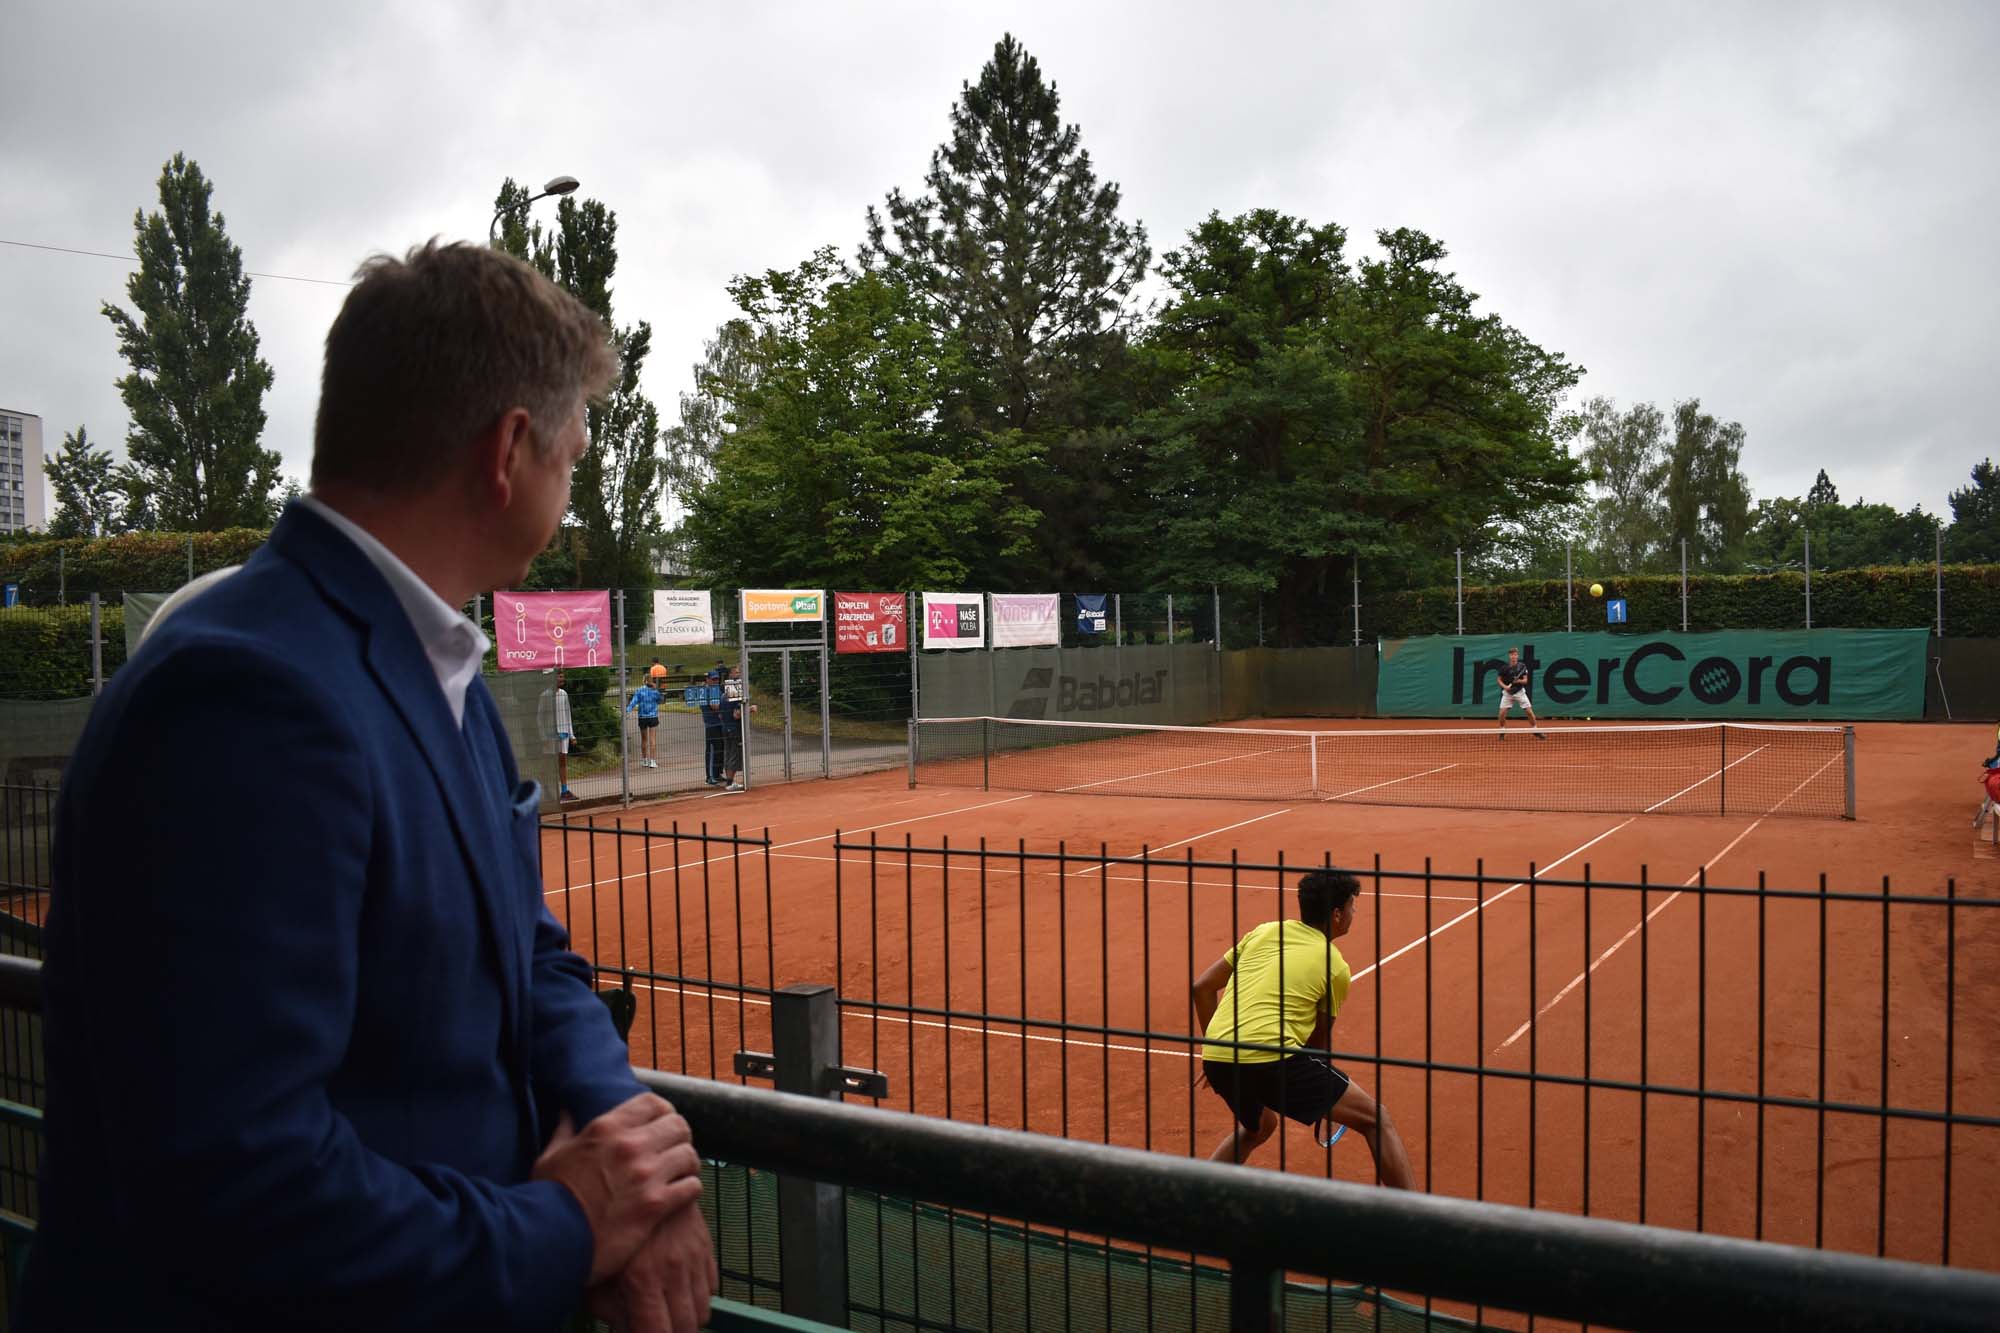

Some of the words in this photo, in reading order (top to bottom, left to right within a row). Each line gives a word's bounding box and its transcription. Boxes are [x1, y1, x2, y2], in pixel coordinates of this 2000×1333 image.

[795, 600, 816, 610] Plzeň
[838, 600, 869, 609] KOMPLETNÍ
[839, 612, 875, 621] ZABEZPEČENÍ
[960, 608, 976, 620] NAŠE
[1612, 601, 1621, 621] 1
[960, 621, 977, 631] VOLBA
[506, 649, 538, 660] innogy
[1452, 642, 1833, 706] InterCora
[1057, 670, 1168, 713] Babolat
